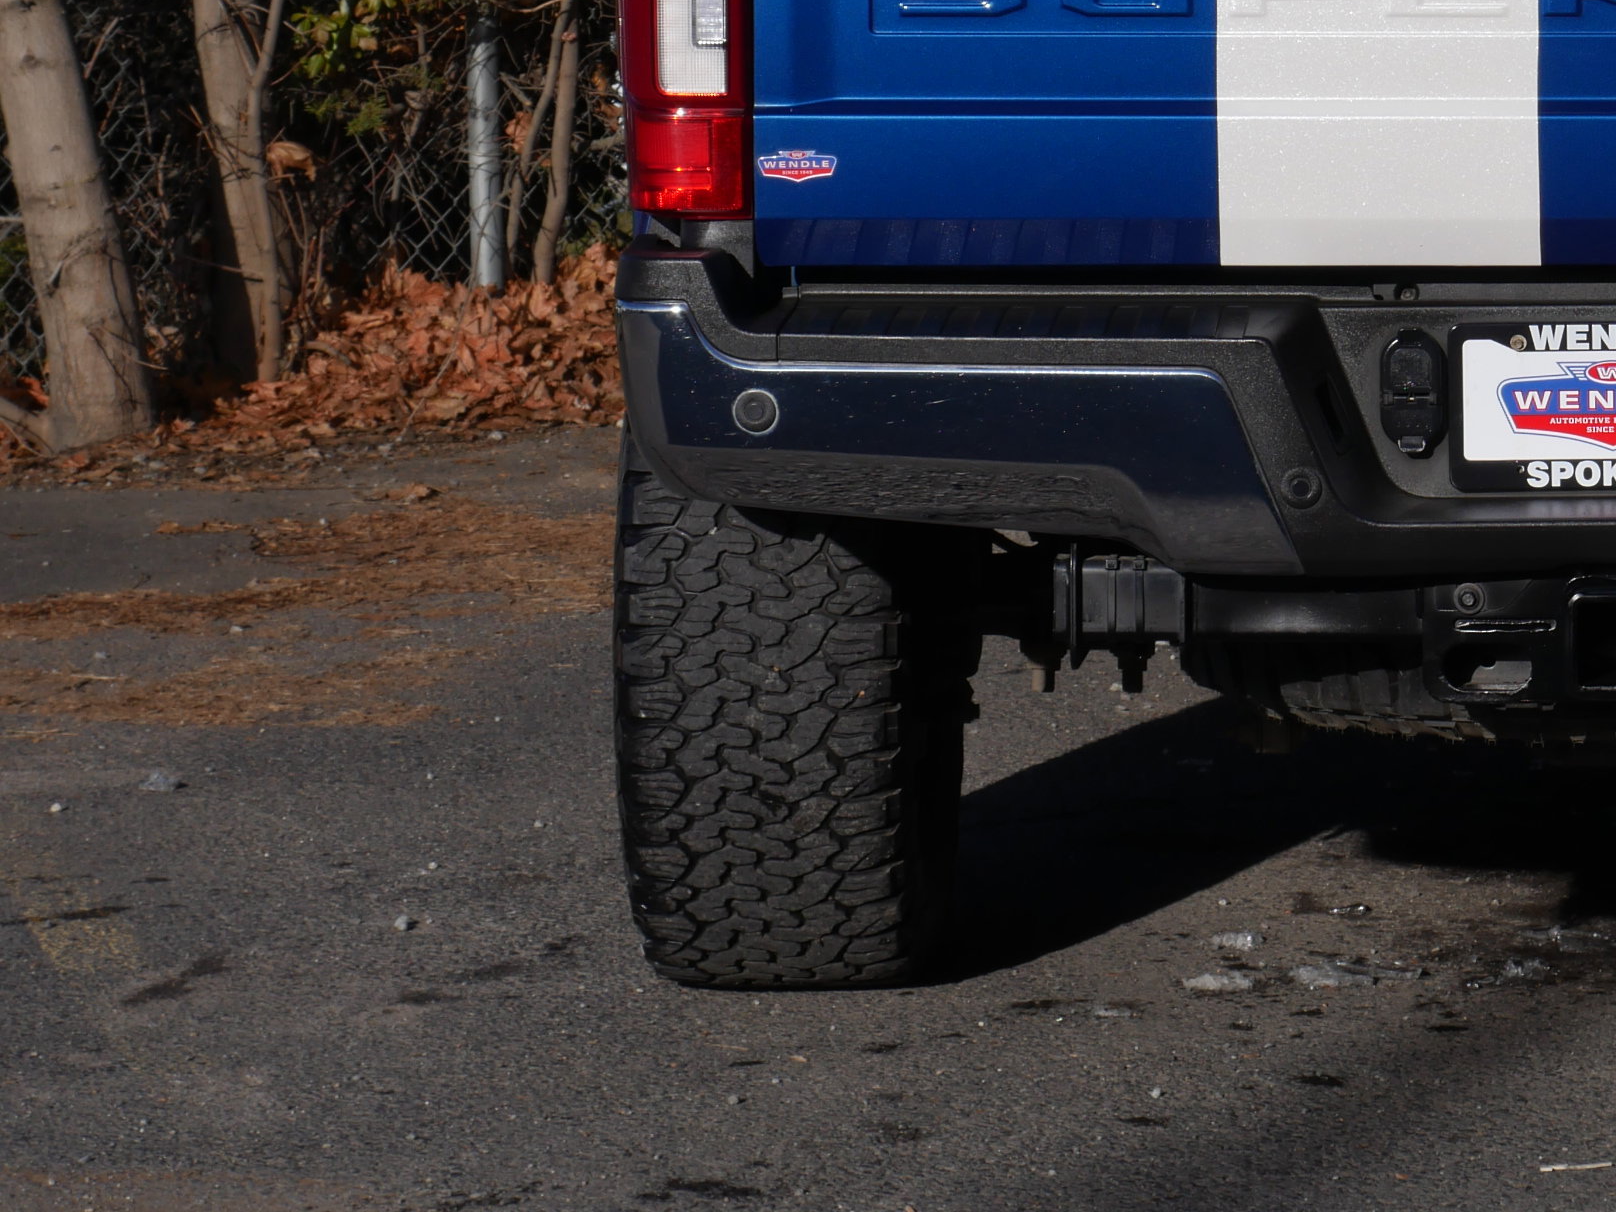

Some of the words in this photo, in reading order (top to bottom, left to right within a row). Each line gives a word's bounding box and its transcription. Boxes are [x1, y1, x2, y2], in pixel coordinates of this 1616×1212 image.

[763, 160, 830, 168] WENDLE
[1549, 416, 1611, 425] AUTOMOTIVE
[1586, 425, 1615, 433] SINCE
